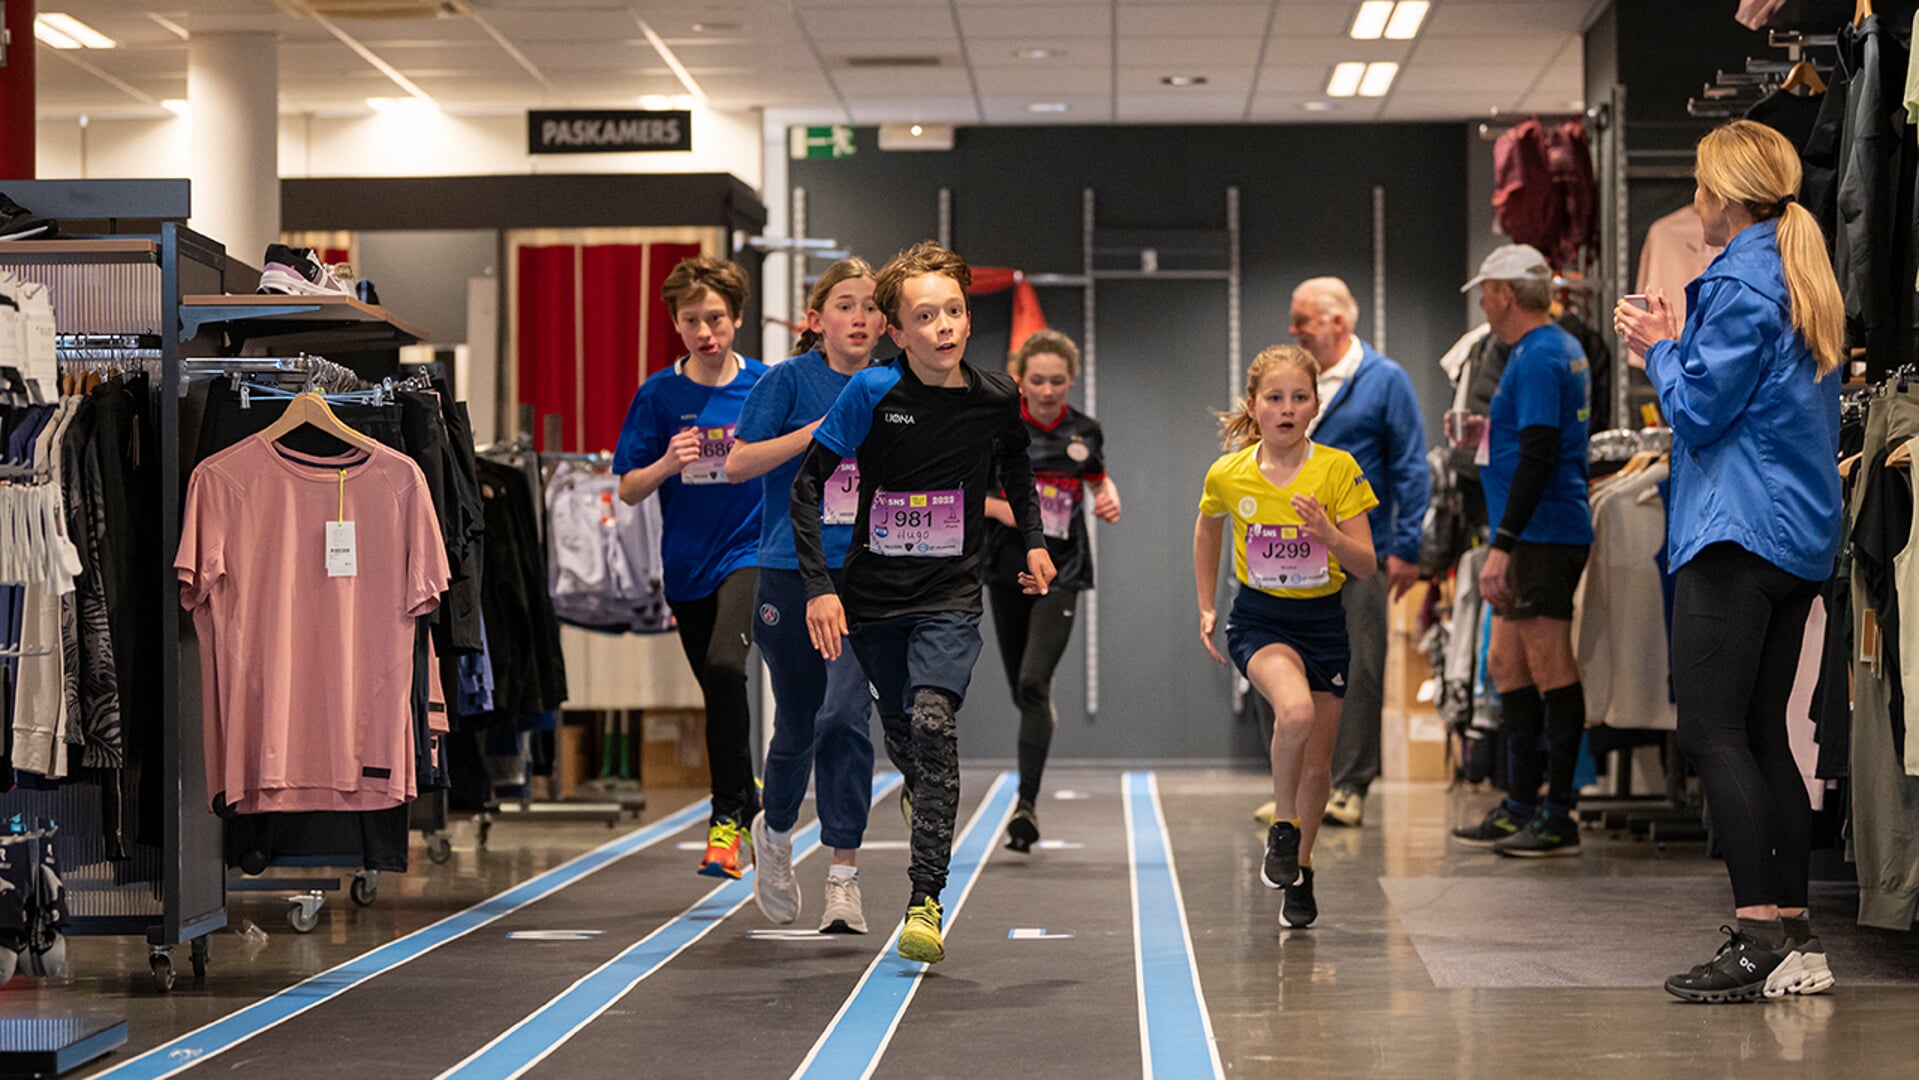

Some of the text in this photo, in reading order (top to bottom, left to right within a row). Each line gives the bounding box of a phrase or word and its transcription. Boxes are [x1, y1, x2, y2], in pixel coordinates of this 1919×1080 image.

[542, 118, 680, 146] PASKAMERS
[887, 498, 905, 506] SNS
[894, 510, 933, 528] 981
[896, 529, 930, 544] Hugo
[1262, 529, 1277, 538] SNS
[1262, 541, 1311, 560] J299
